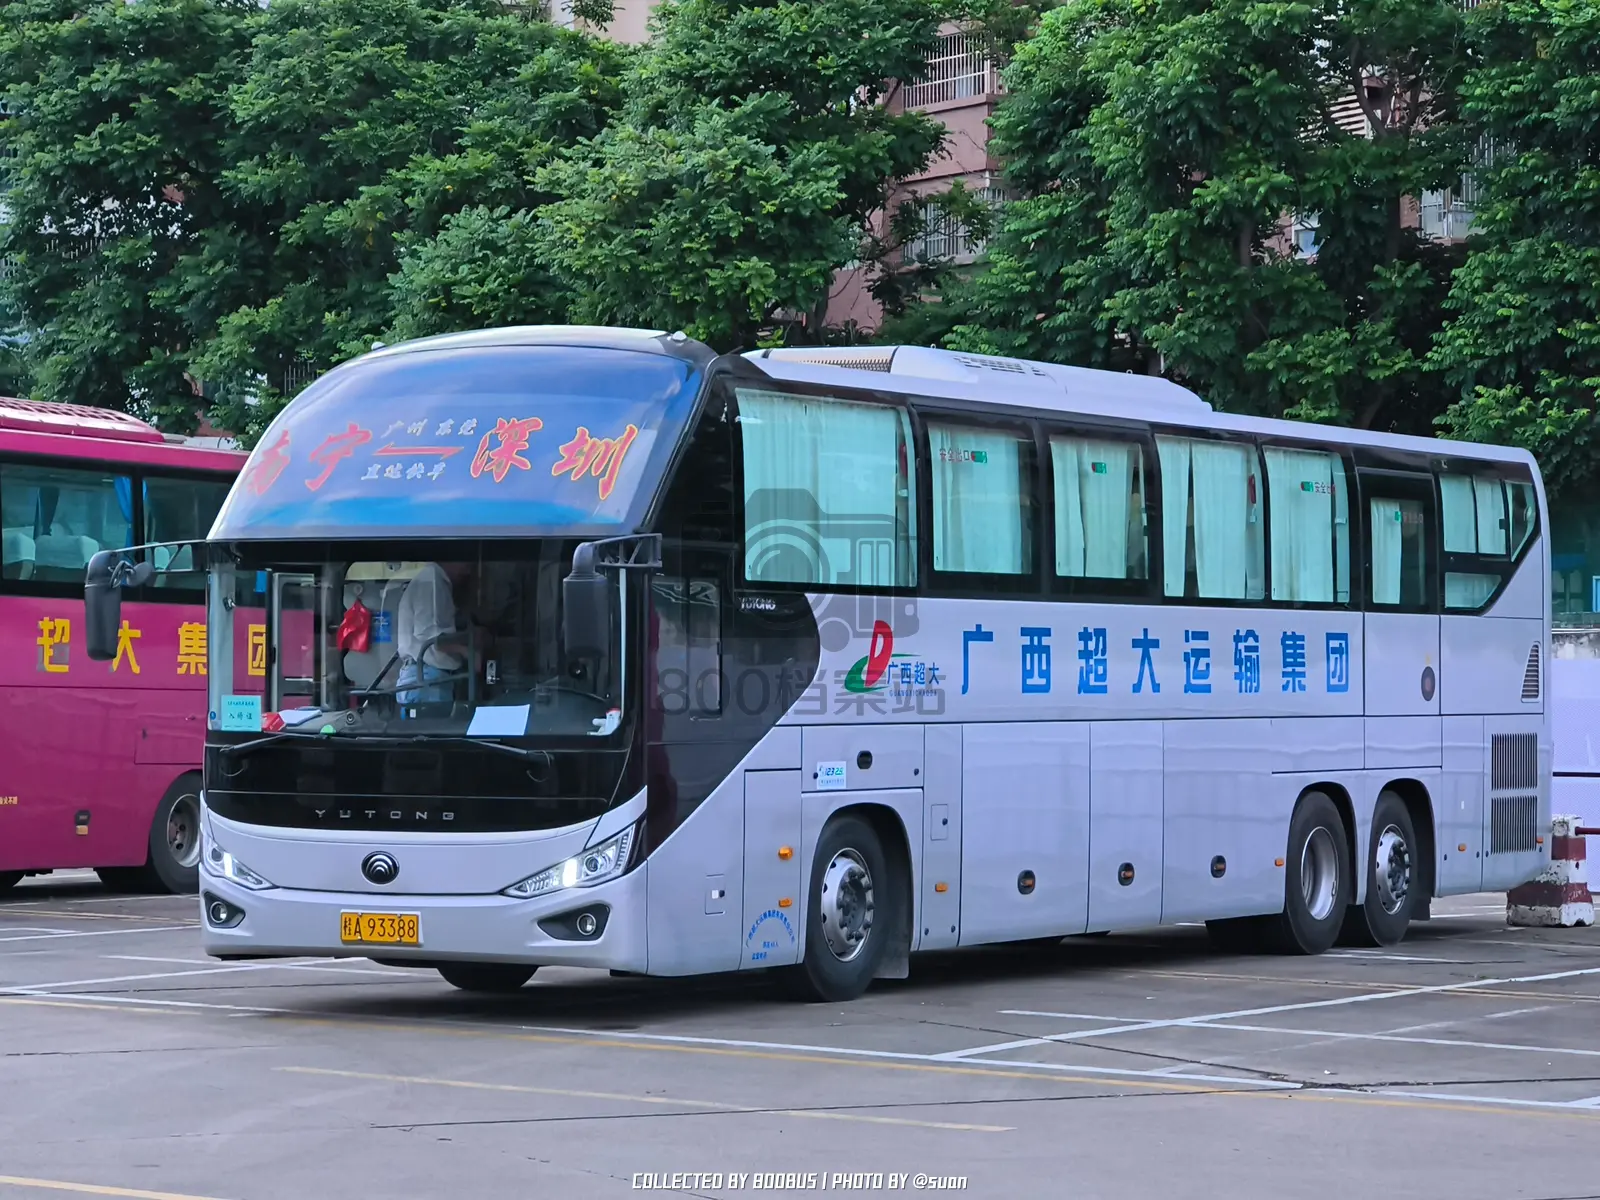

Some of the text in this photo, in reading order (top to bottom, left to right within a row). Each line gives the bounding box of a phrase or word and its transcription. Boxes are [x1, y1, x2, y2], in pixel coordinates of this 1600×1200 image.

[380, 418, 428, 438] 广州
[470, 416, 638, 500] 深圳
[961, 624, 1349, 695] 广西超大运输集团
[887, 661, 940, 685] 广西超大
[315, 810, 455, 821] YUTONG
